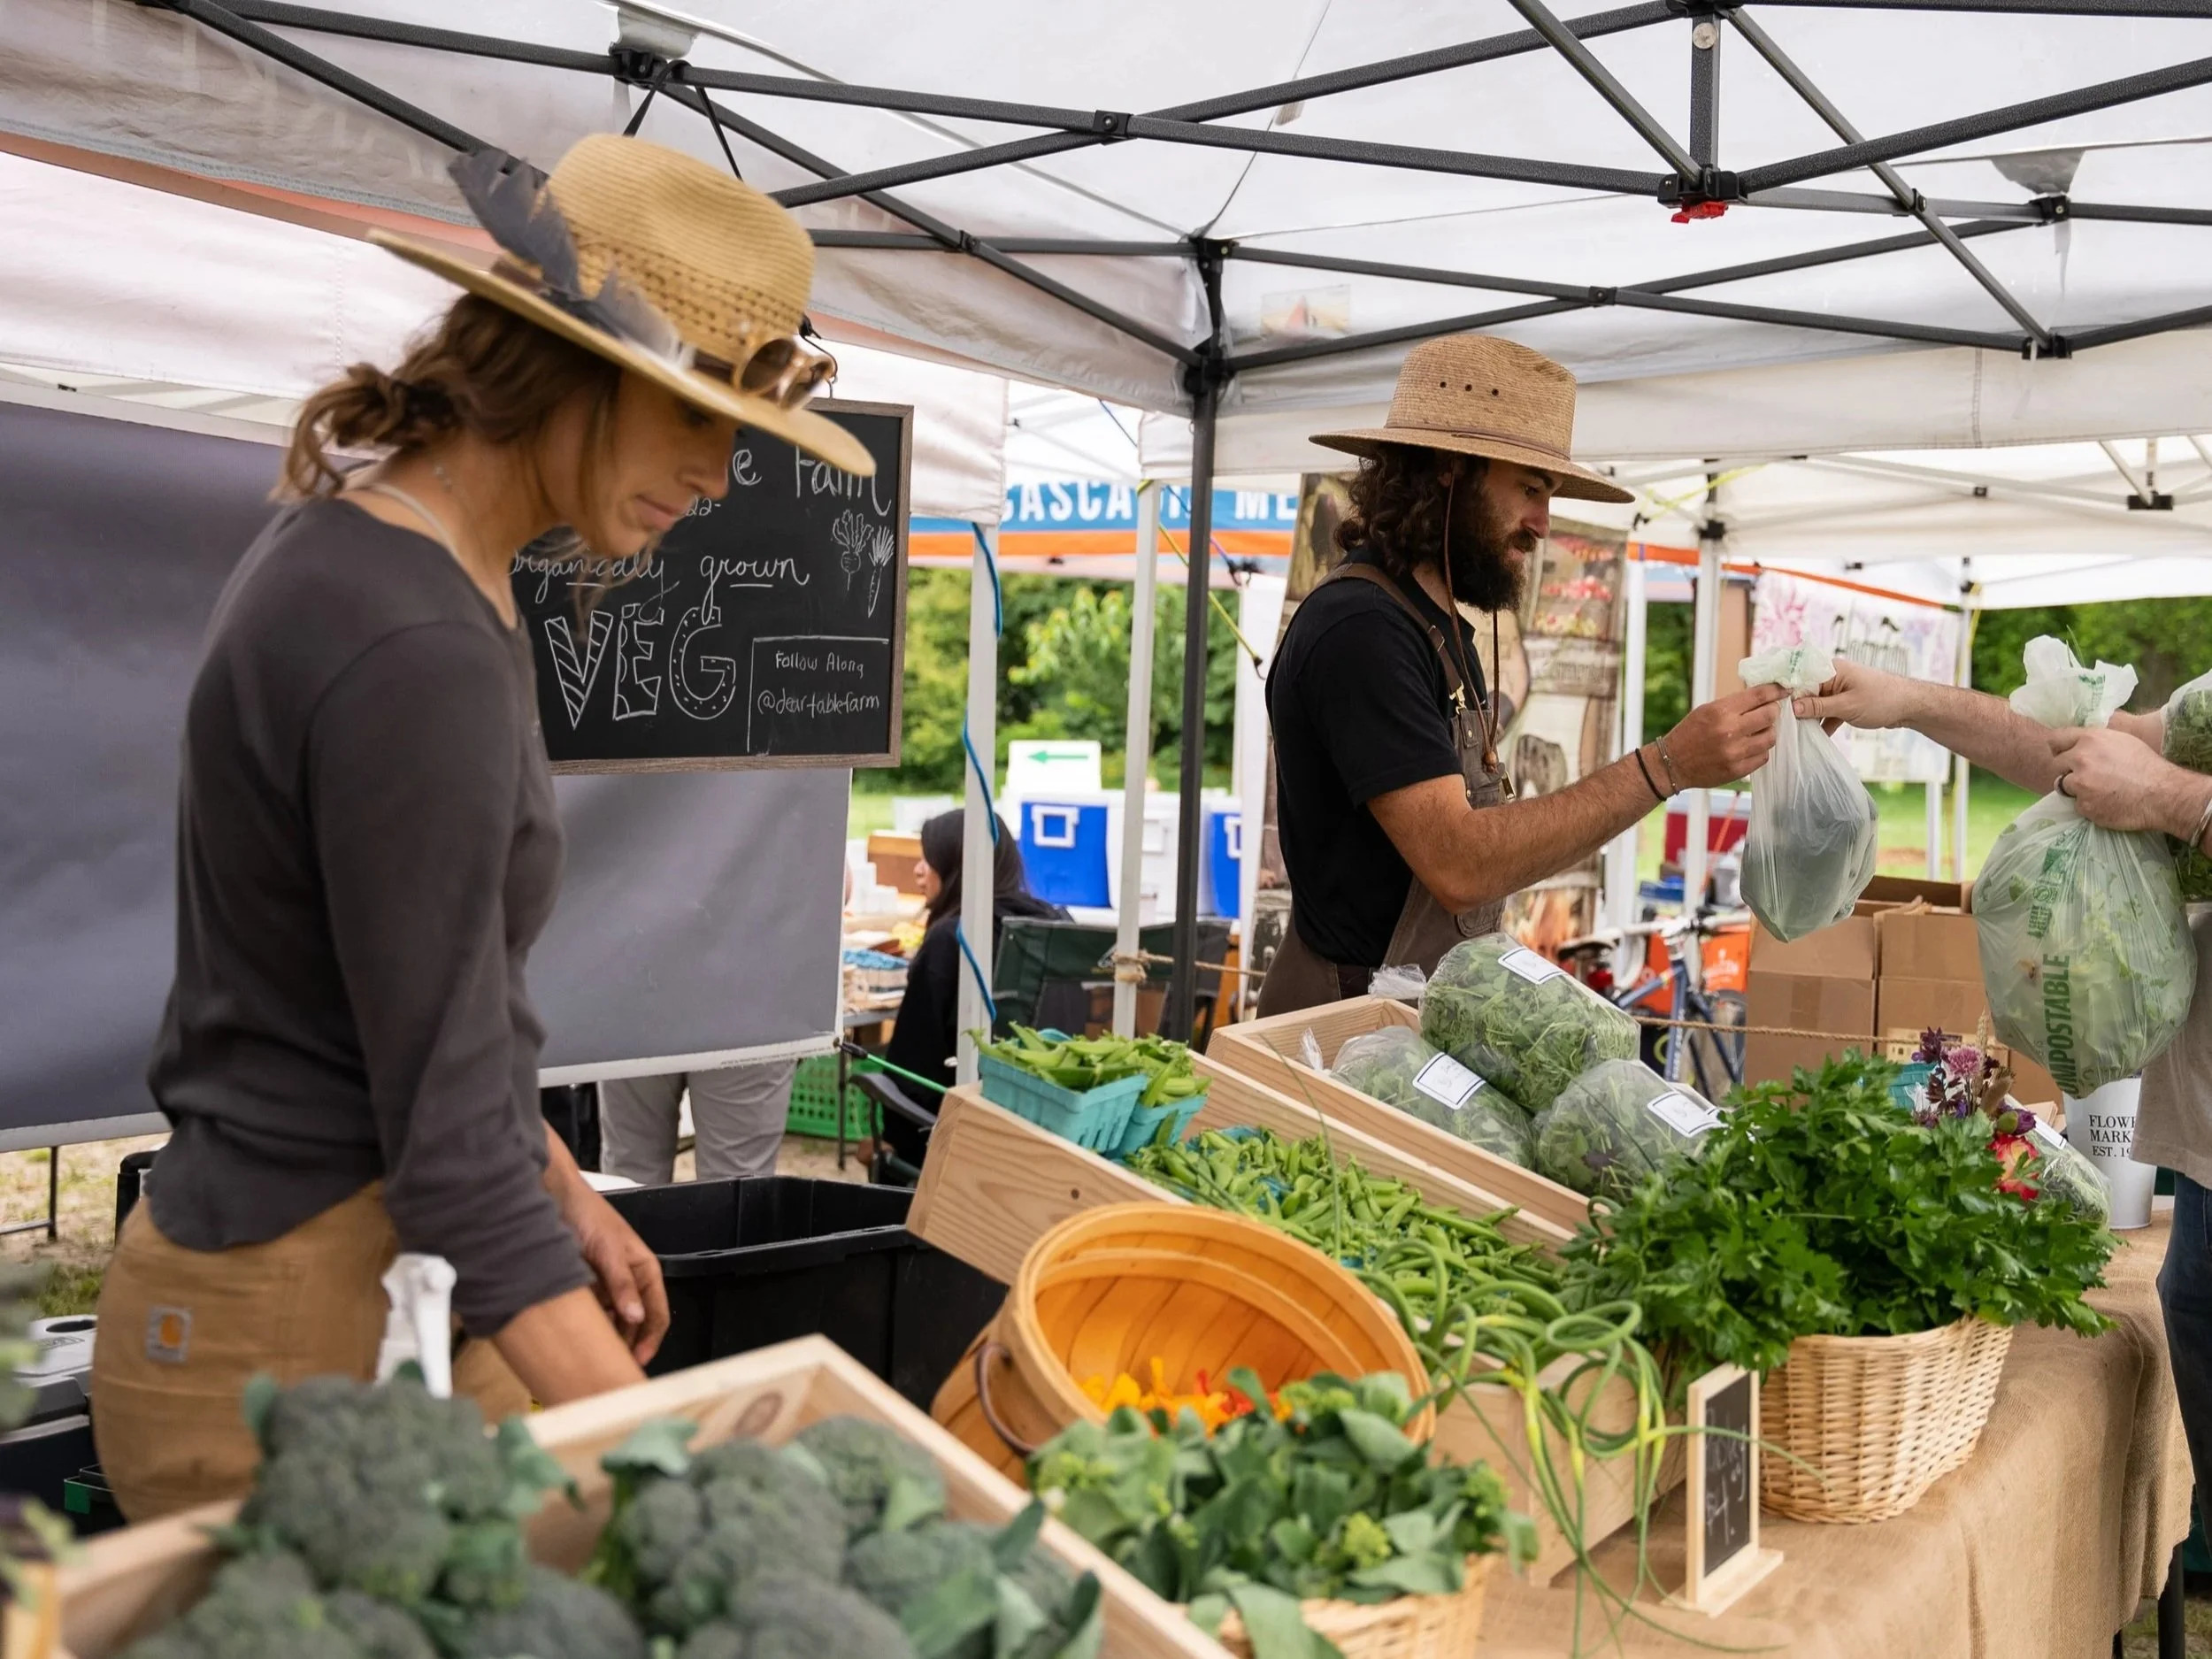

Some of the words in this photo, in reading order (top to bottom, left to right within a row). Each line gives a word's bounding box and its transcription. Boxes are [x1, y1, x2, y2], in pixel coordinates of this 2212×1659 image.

[701, 555, 810, 626] grown
[544, 603, 736, 731] VEG
[776, 651, 818, 672] Follow
[826, 651, 864, 680] Along
[757, 687, 879, 718] @deartablefarm
[2042, 953, 2081, 1099] OMPOSTABLE
[2093, 1145, 2117, 1158] EST.
